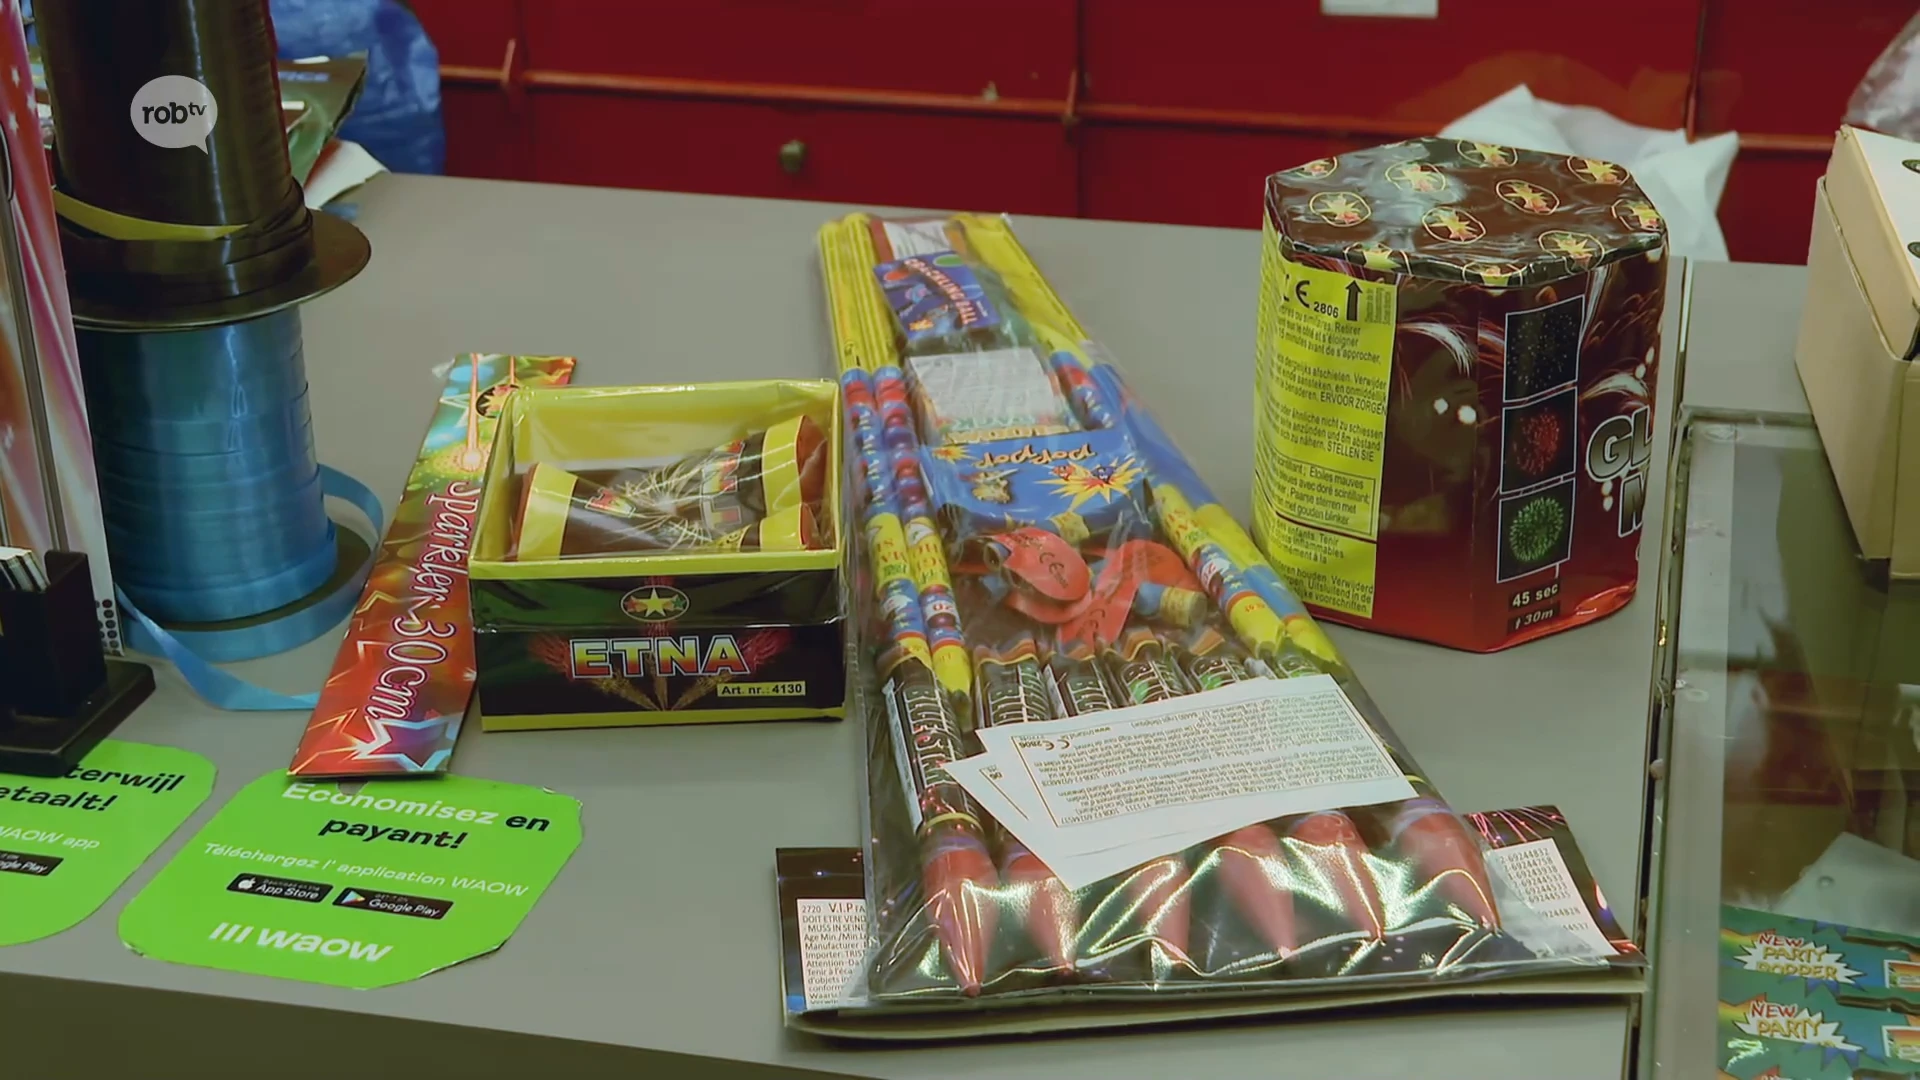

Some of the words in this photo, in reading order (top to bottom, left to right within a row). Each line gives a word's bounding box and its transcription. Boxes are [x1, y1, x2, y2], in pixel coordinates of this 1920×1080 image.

[955, 301, 978, 325] BALL
[1313, 302, 1339, 318] 2806
[1335, 322, 1361, 335] Retirer
[1326, 343, 1335, 355] de
[1335, 384, 1345, 393] en
[1320, 392, 1354, 407] ERVOOR
[1355, 399, 1386, 416] ZORGEN
[1340, 421, 1348, 430] zu
[1349, 422, 1383, 439] schiessen
[1327, 441, 1360, 458] STELLEN
[1360, 450, 1374, 462] SIE
[1342, 502, 1356, 514] met
[413, 481, 482, 609] Sparkler
[1361, 594, 1372, 604] de
[1512, 592, 1530, 607] 45
[1535, 584, 1559, 600] sec
[1524, 609, 1554, 626] 30m
[570, 634, 750, 679] ETNA
[366, 615, 456, 720] 30cm
[721, 685, 745, 696] Art.
[772, 683, 802, 695] 4130
[282, 783, 500, 825] Economisez
[505, 815, 551, 832] en
[63, 836, 100, 850] app
[317, 819, 469, 850] payant!
[21, 862, 48, 873] Play
[204, 843, 319, 870] Téléchargez
[337, 862, 446, 886] application
[451, 876, 529, 897] WAOW
[255, 883, 283, 897] App
[284, 887, 319, 899] Store
[368, 899, 413, 913] Google
[413, 904, 440, 917] Play
[802, 905, 821, 913] 2720
[829, 903, 853, 913] V.I.P
[802, 915, 820, 923] DOIT
[823, 915, 841, 923] ETRE
[256, 926, 394, 963] waow
[1759, 932, 1803, 947] NEW
[1762, 946, 1827, 962] PARTY
[1751, 1000, 1797, 1017] NEW
[1757, 1019, 1821, 1039] PARTY
